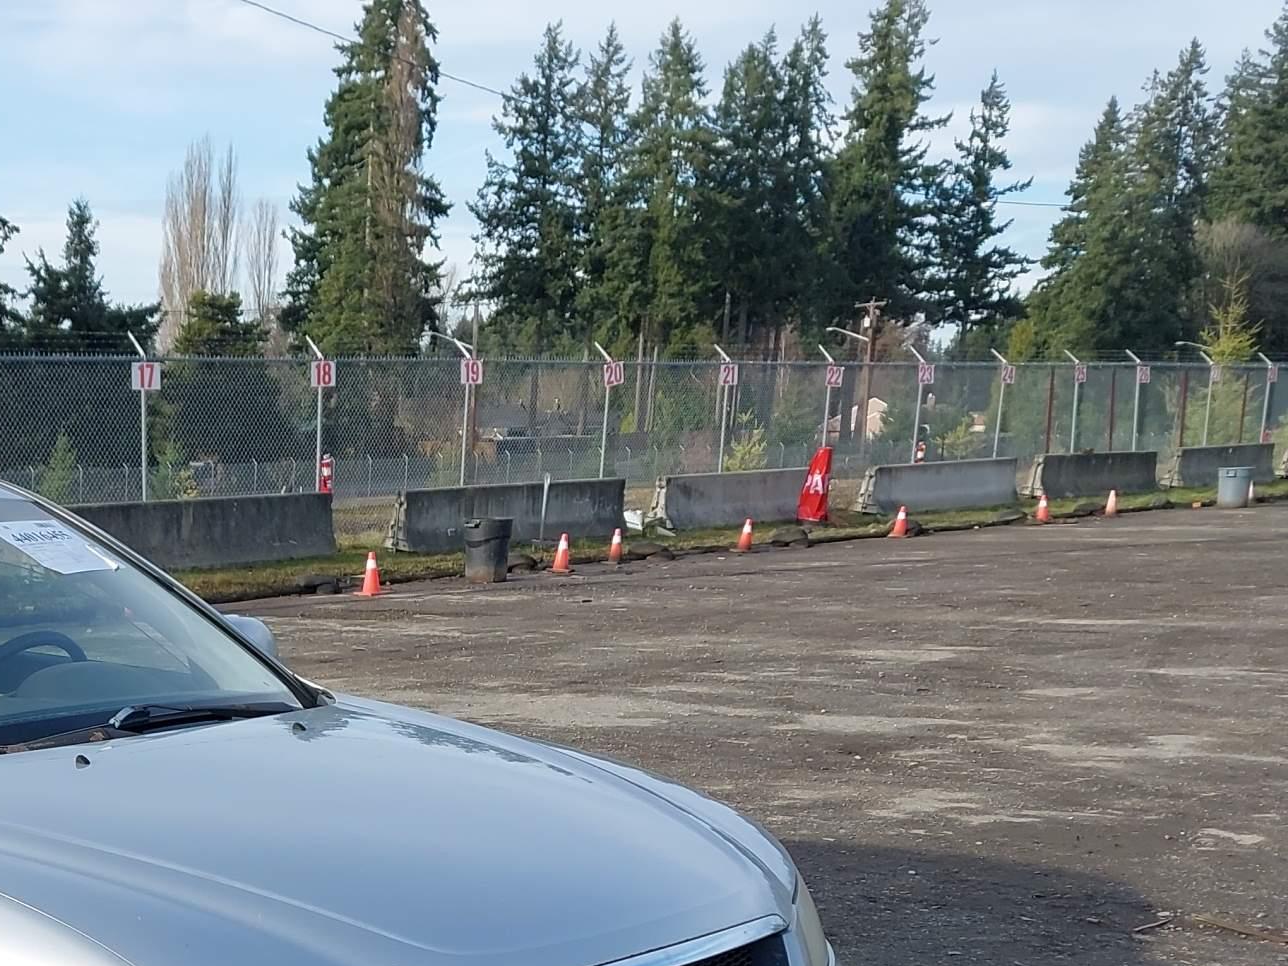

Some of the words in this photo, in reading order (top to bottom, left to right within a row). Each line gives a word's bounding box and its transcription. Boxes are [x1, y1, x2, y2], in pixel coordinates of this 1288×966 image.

[138, 363, 154, 388] 17
[315, 362, 332, 386] 18
[464, 361, 479, 383] 19
[606, 363, 622, 385] 20
[723, 365, 736, 384] 21
[827, 367, 842, 386] 22
[919, 366, 933, 383] 23
[1002, 366, 1014, 382] 24
[11, 529, 73, 544] 44016455
